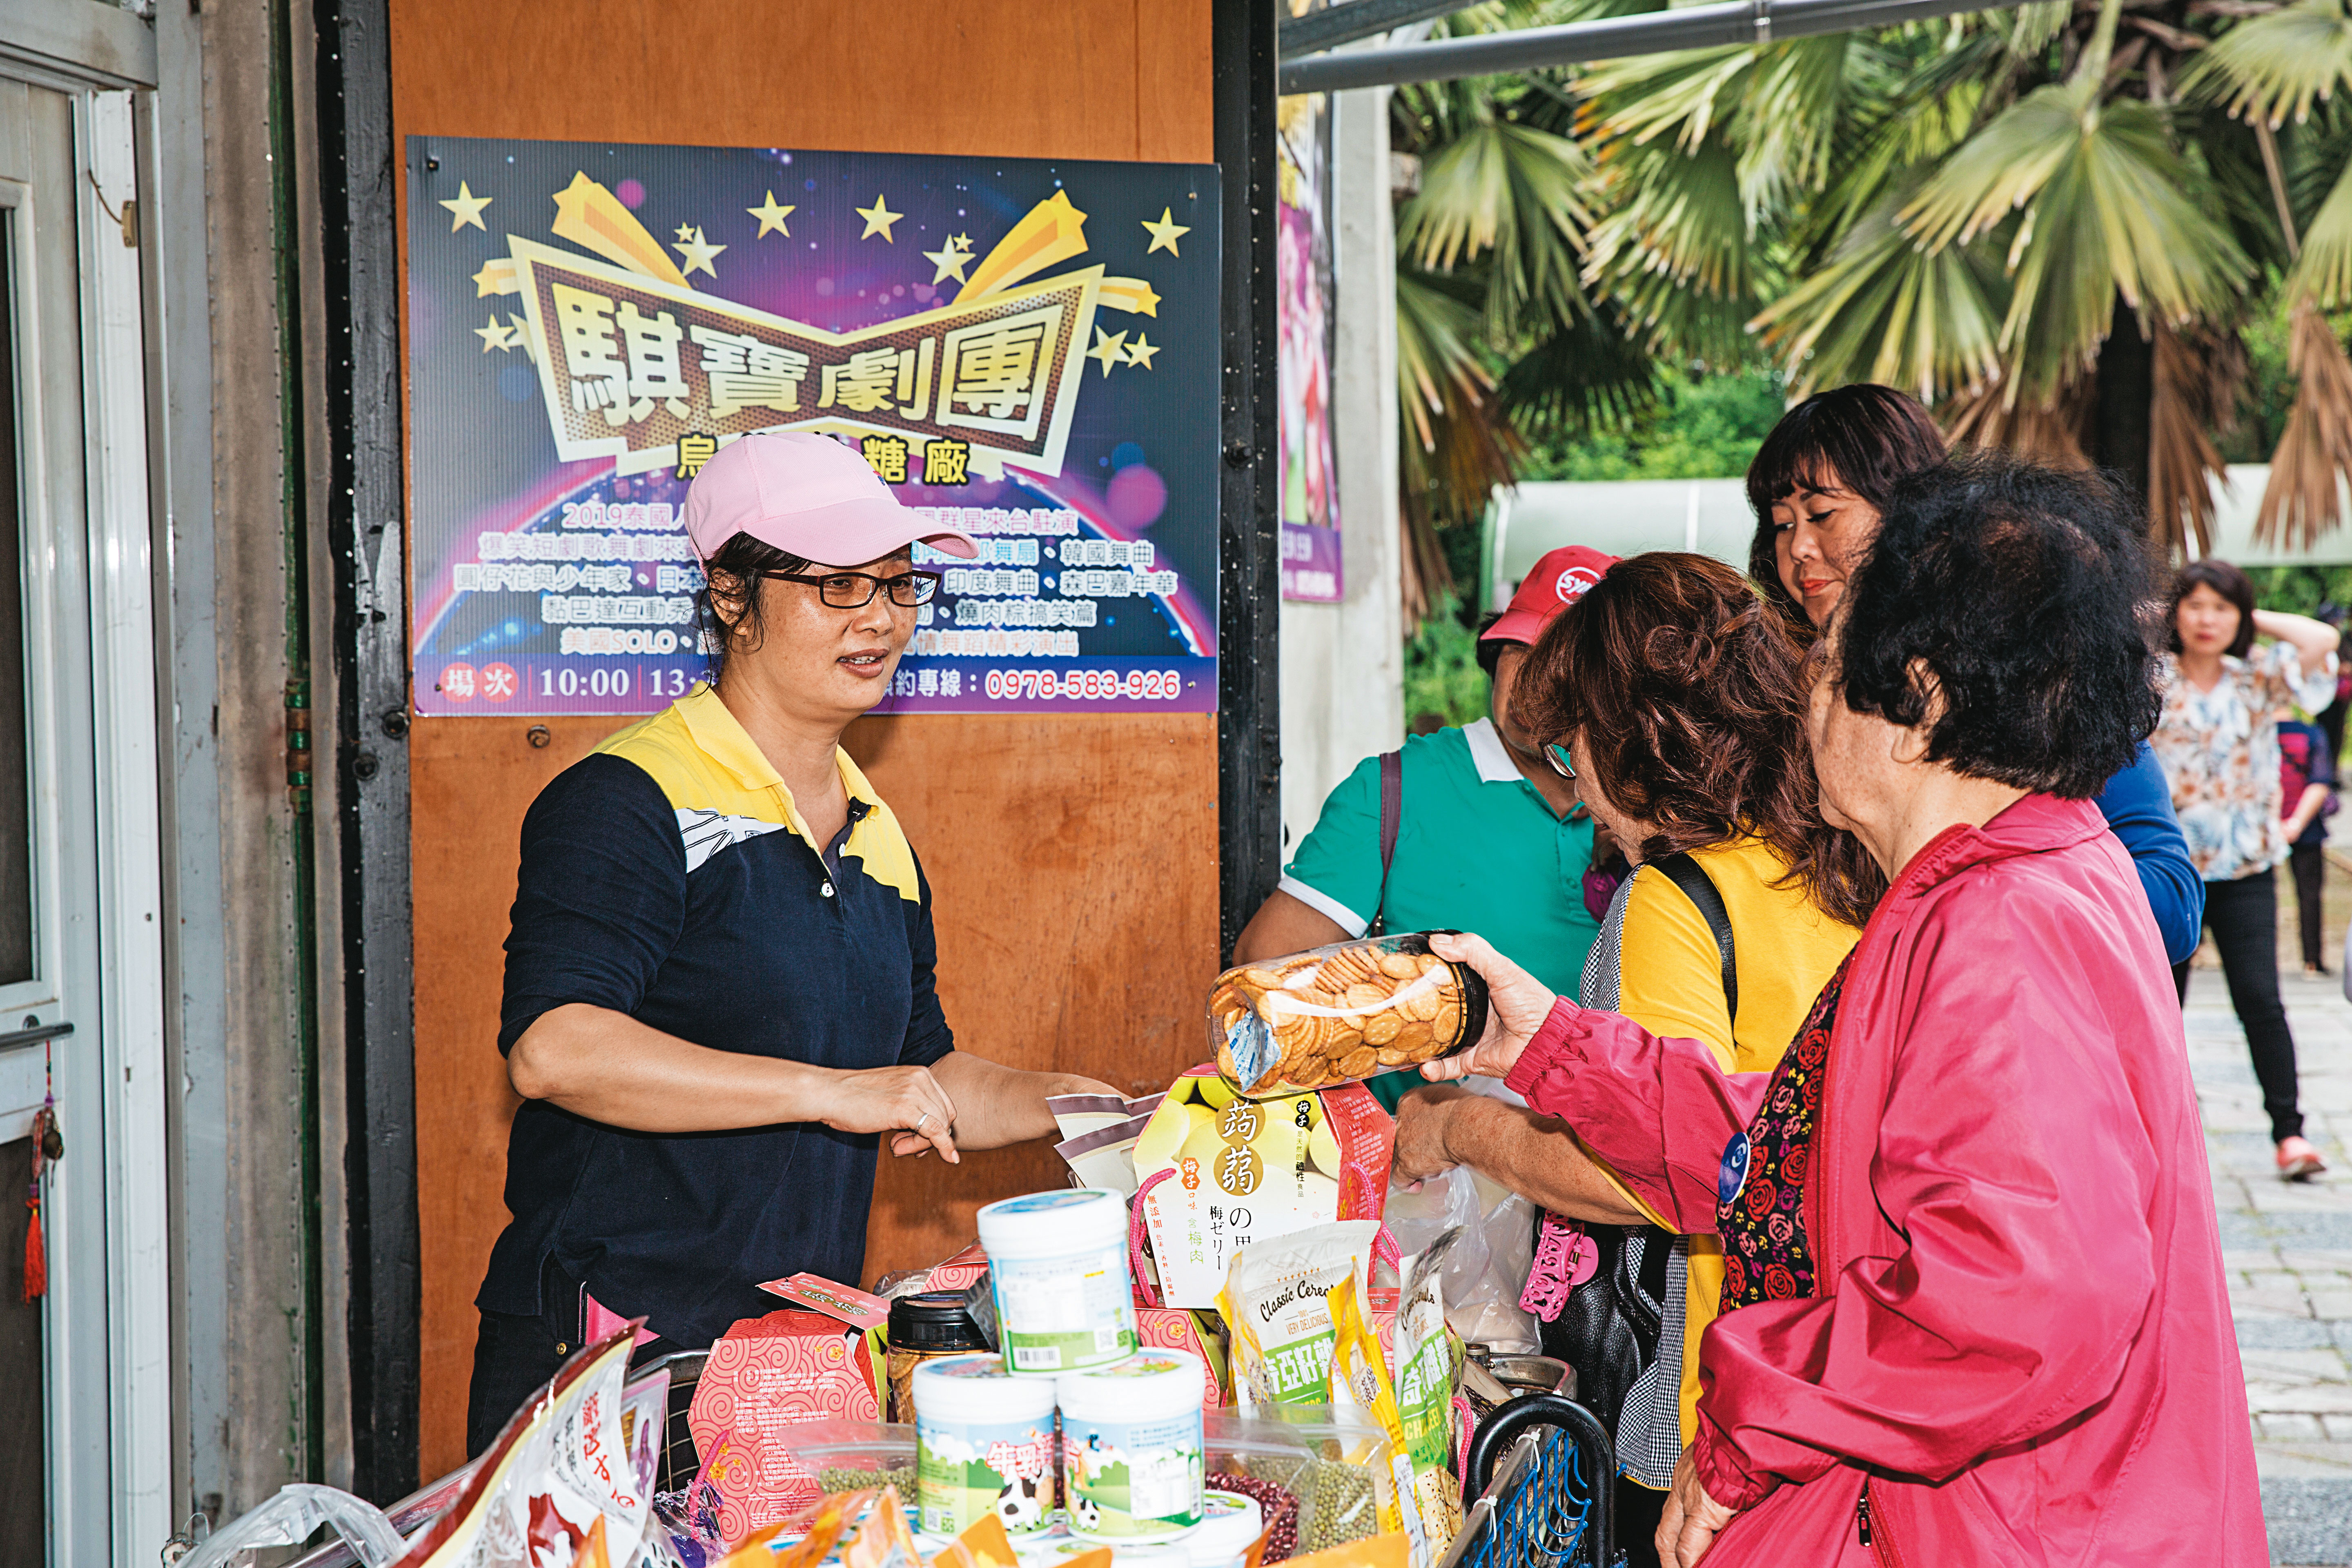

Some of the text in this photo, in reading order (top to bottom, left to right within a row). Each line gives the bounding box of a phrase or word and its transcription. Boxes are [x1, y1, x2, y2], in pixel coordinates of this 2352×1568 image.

[551, 282, 1064, 443] 騏寶劇團
[445, 669, 514, 697] 場次
[540, 668, 629, 697] 10:00
[985, 669, 1180, 699] 0978-583-926
[1297, 1101, 1310, 1127] 梅子
[1221, 1100, 1257, 1194] 蒟蒻
[1183, 1160, 1198, 1188] 梅子
[1147, 1194, 1163, 1229] 無添加
[1209, 1205, 1225, 1271] 梅ゼリー
[1261, 1287, 1294, 1323] Classic
[1298, 1309, 1310, 1319] 100%
[1286, 1313, 1329, 1335] VERY DELICIOUS
